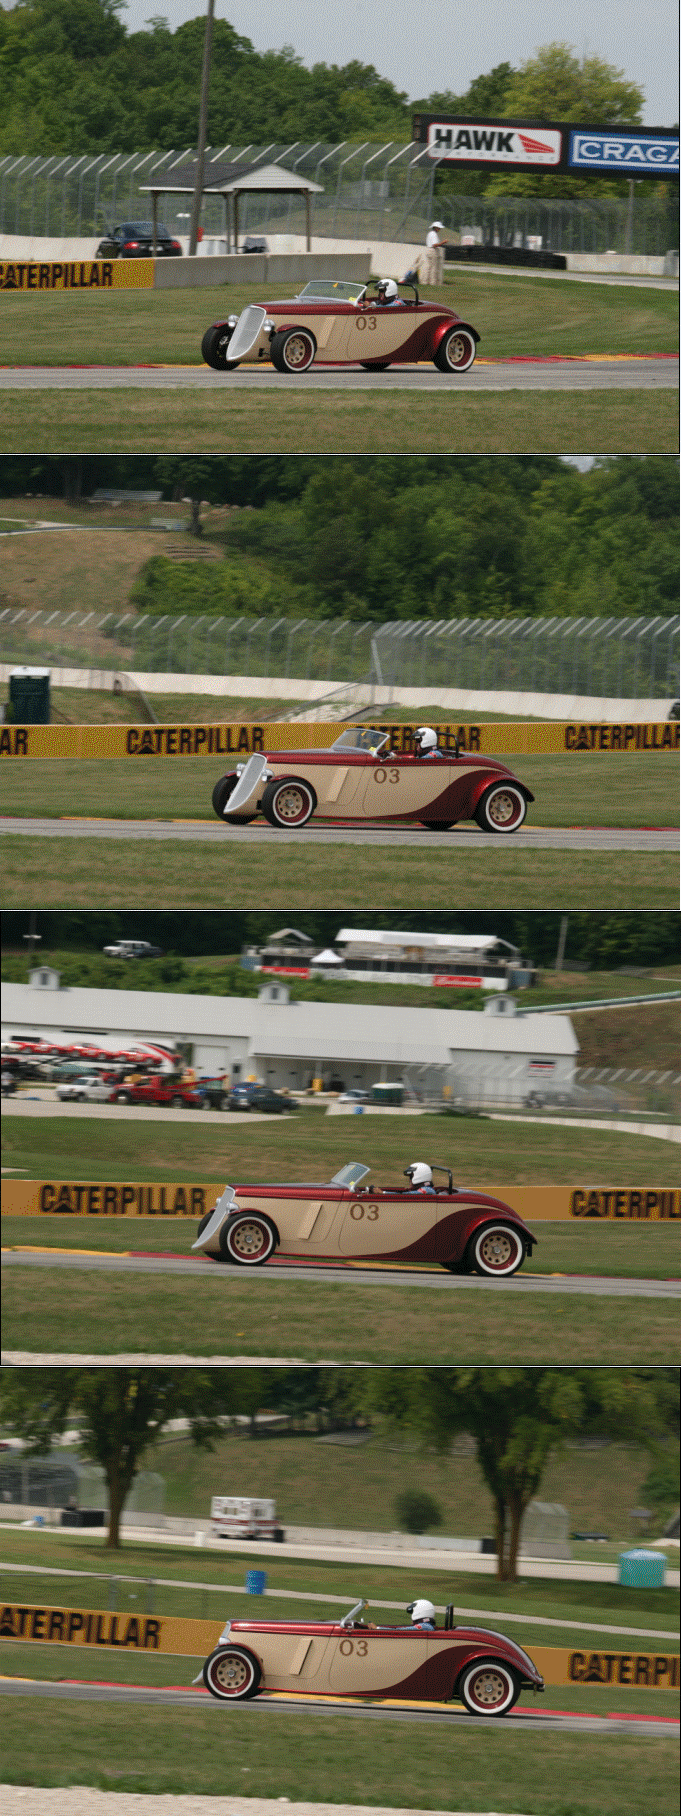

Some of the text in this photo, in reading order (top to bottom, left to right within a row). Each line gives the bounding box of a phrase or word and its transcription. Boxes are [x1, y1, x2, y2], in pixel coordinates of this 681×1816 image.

[435, 129, 515, 152] HAWK
[355, 316, 377, 331] 03
[126, 727, 265, 754] CATERPILLAR
[373, 768, 399, 784] 03
[39, 1185, 207, 1215] CATERPILLAR
[350, 1203, 380, 1221] 03
[339, 1639, 369, 1657] 03
